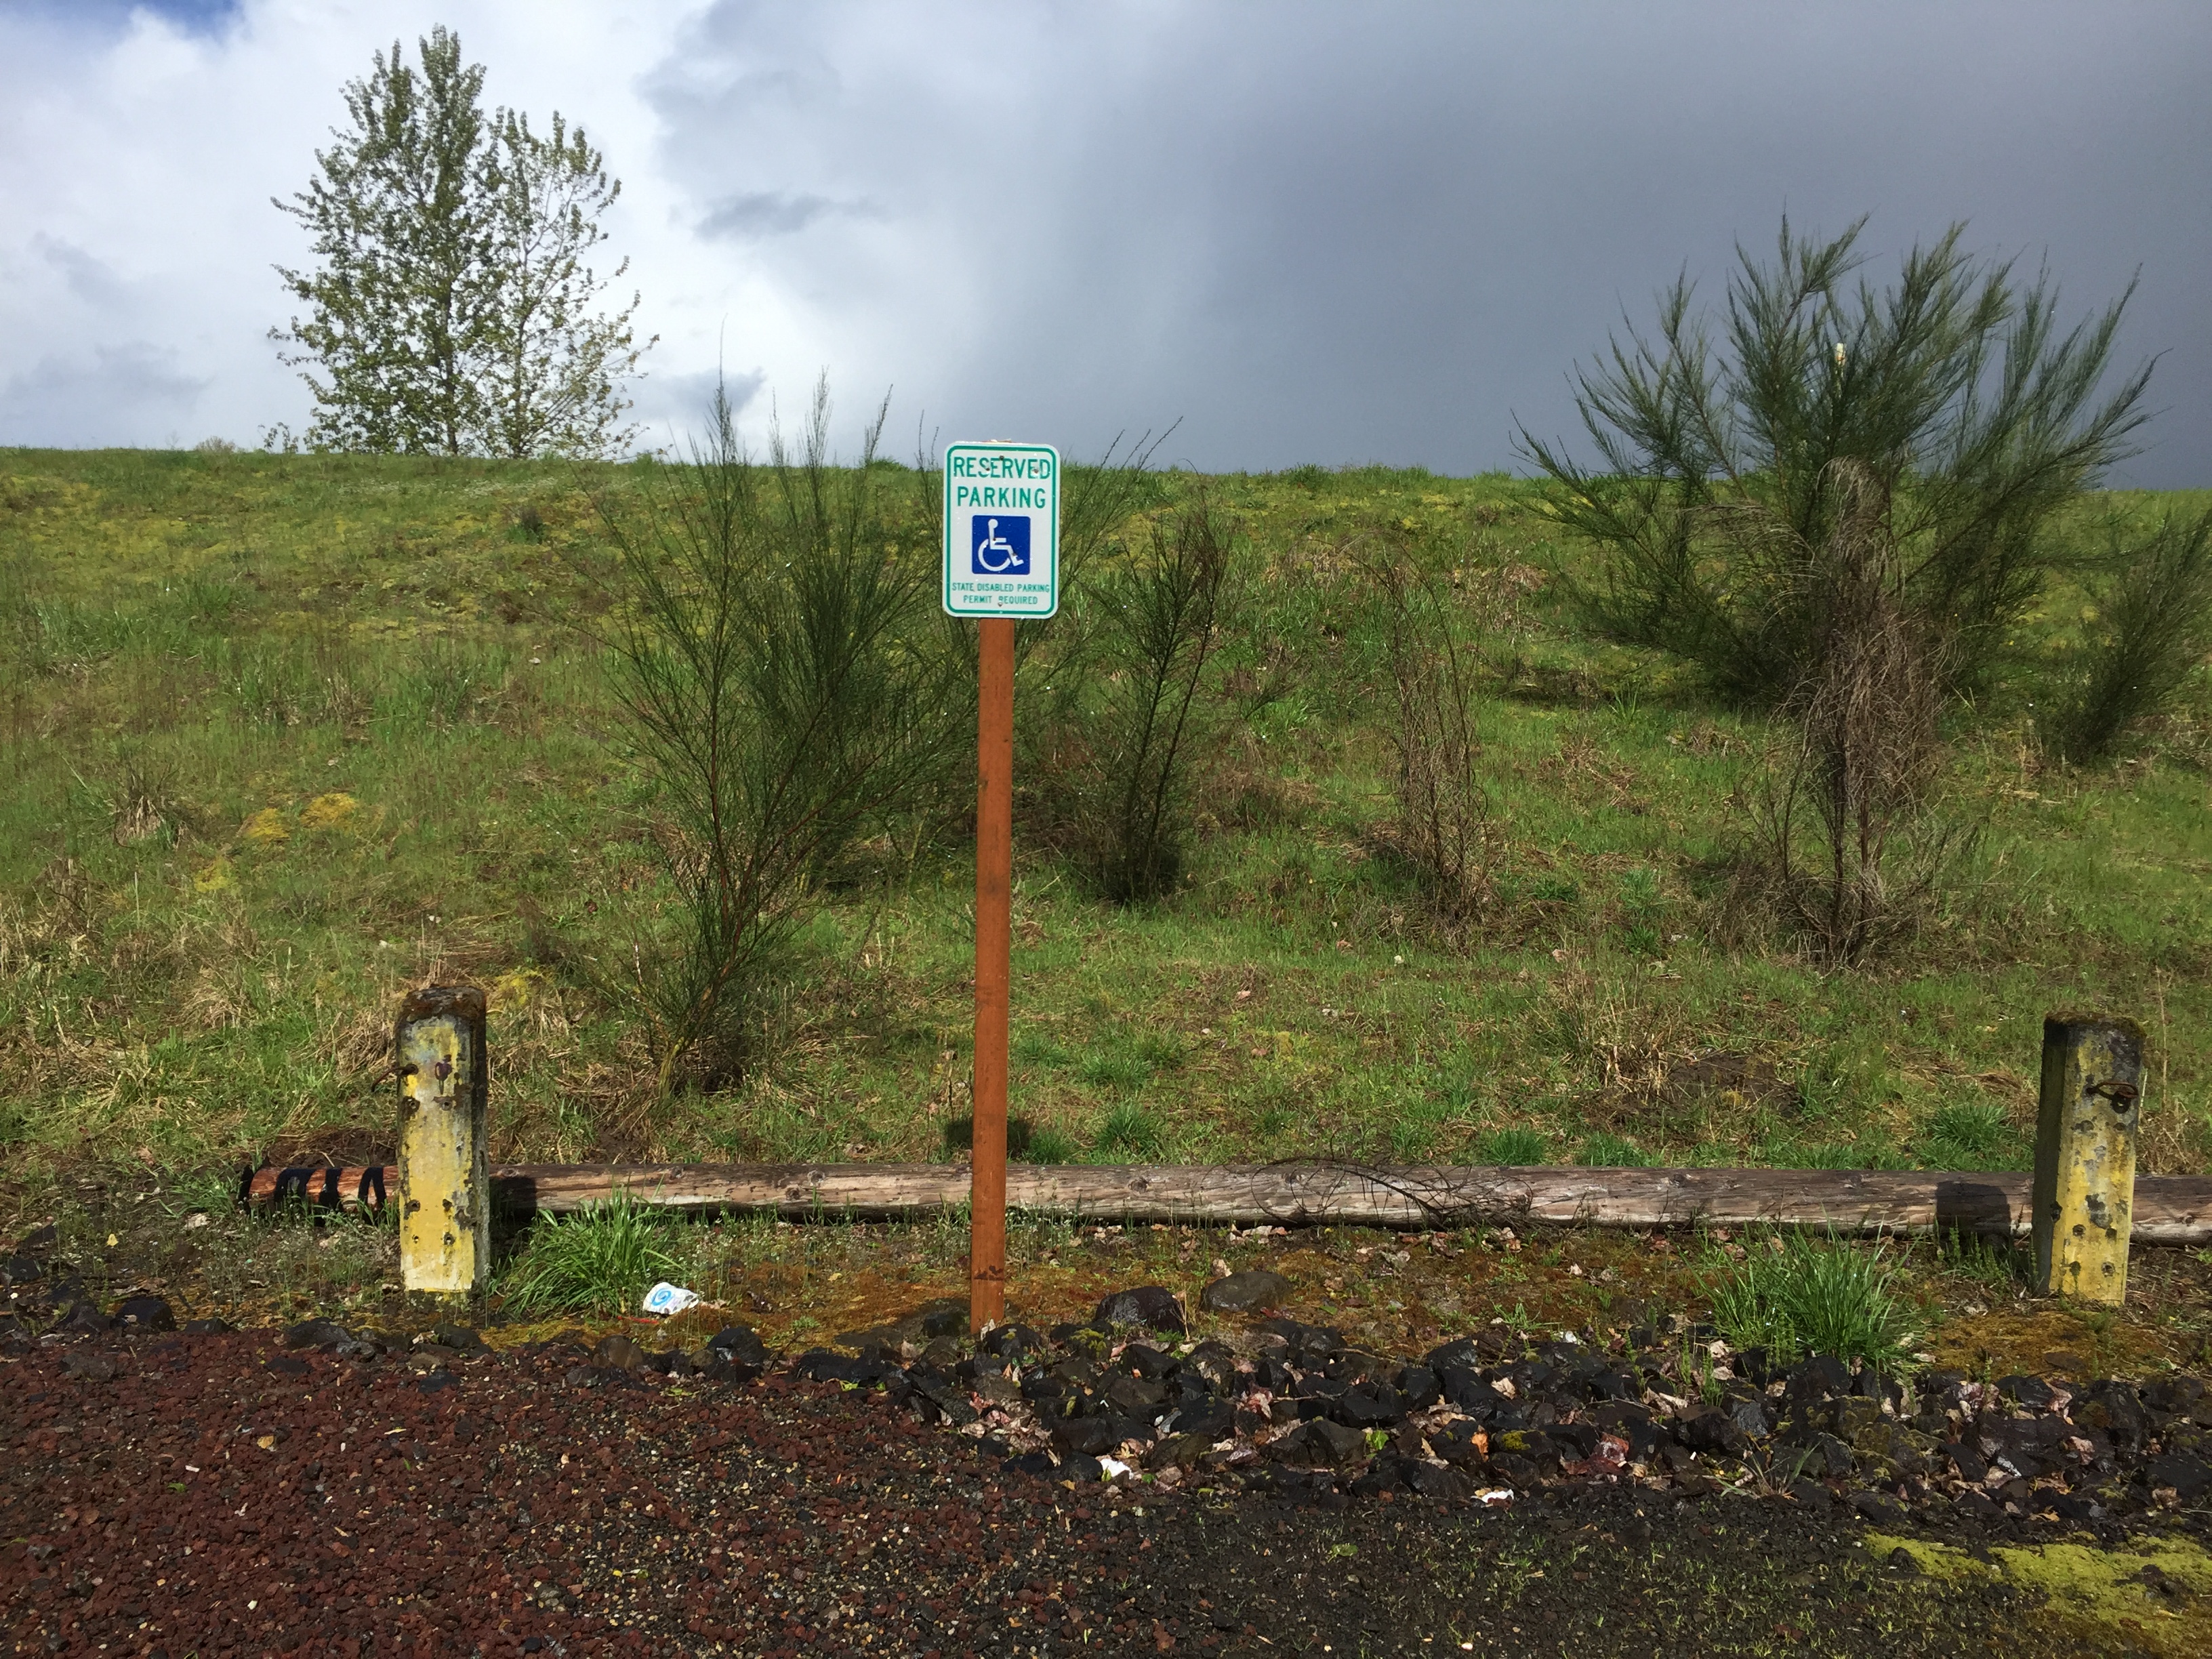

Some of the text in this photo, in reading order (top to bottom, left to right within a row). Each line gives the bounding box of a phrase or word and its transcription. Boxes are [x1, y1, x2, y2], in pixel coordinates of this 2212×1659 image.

[954, 456, 1051, 480] RESERVED
[957, 486, 1046, 509] PARKING
[951, 582, 1050, 592] STATE DISABLED PARKING
[963, 595, 1038, 605] PERMIT REQUIRED
